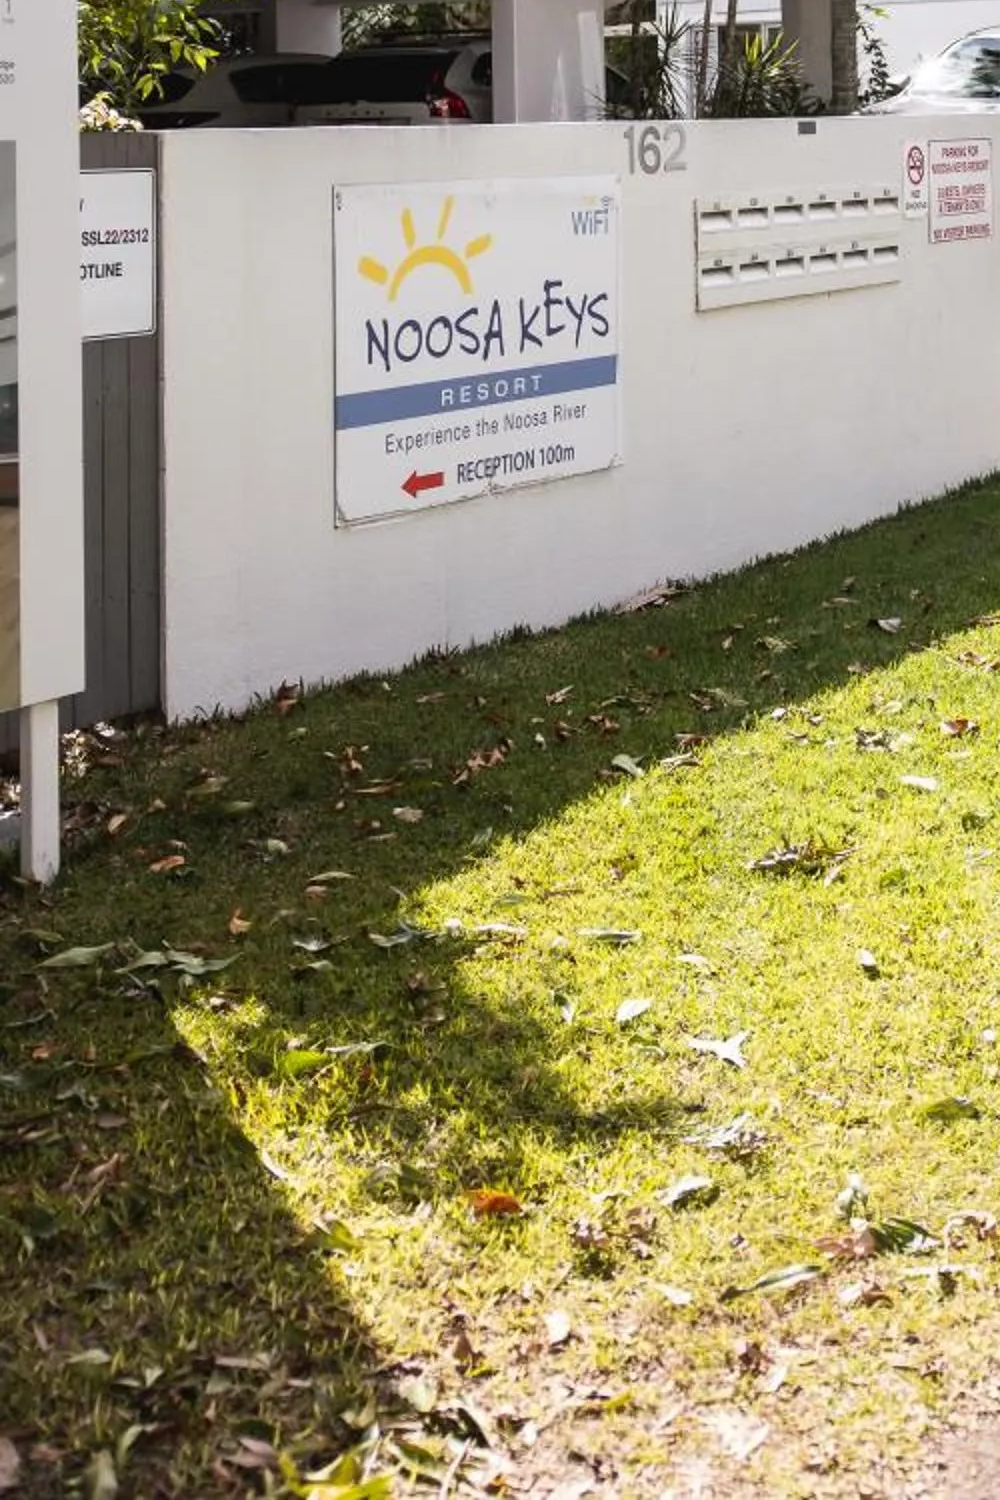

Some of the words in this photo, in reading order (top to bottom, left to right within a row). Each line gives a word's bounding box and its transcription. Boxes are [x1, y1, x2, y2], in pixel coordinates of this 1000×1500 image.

[623, 123, 688, 176] 162
[81, 228, 149, 247] SSL22/2312
[571, 209, 609, 236] WiFi
[365, 299, 505, 373] NOOSA
[519, 279, 610, 353] KEYS
[441, 374, 543, 408] RESORT
[385, 423, 471, 455] Experience
[476, 418, 499, 437] the
[503, 410, 548, 432] Noosa
[553, 403, 588, 423] River
[456, 450, 535, 484] RECEPTION
[539, 443, 575, 468] 100m
